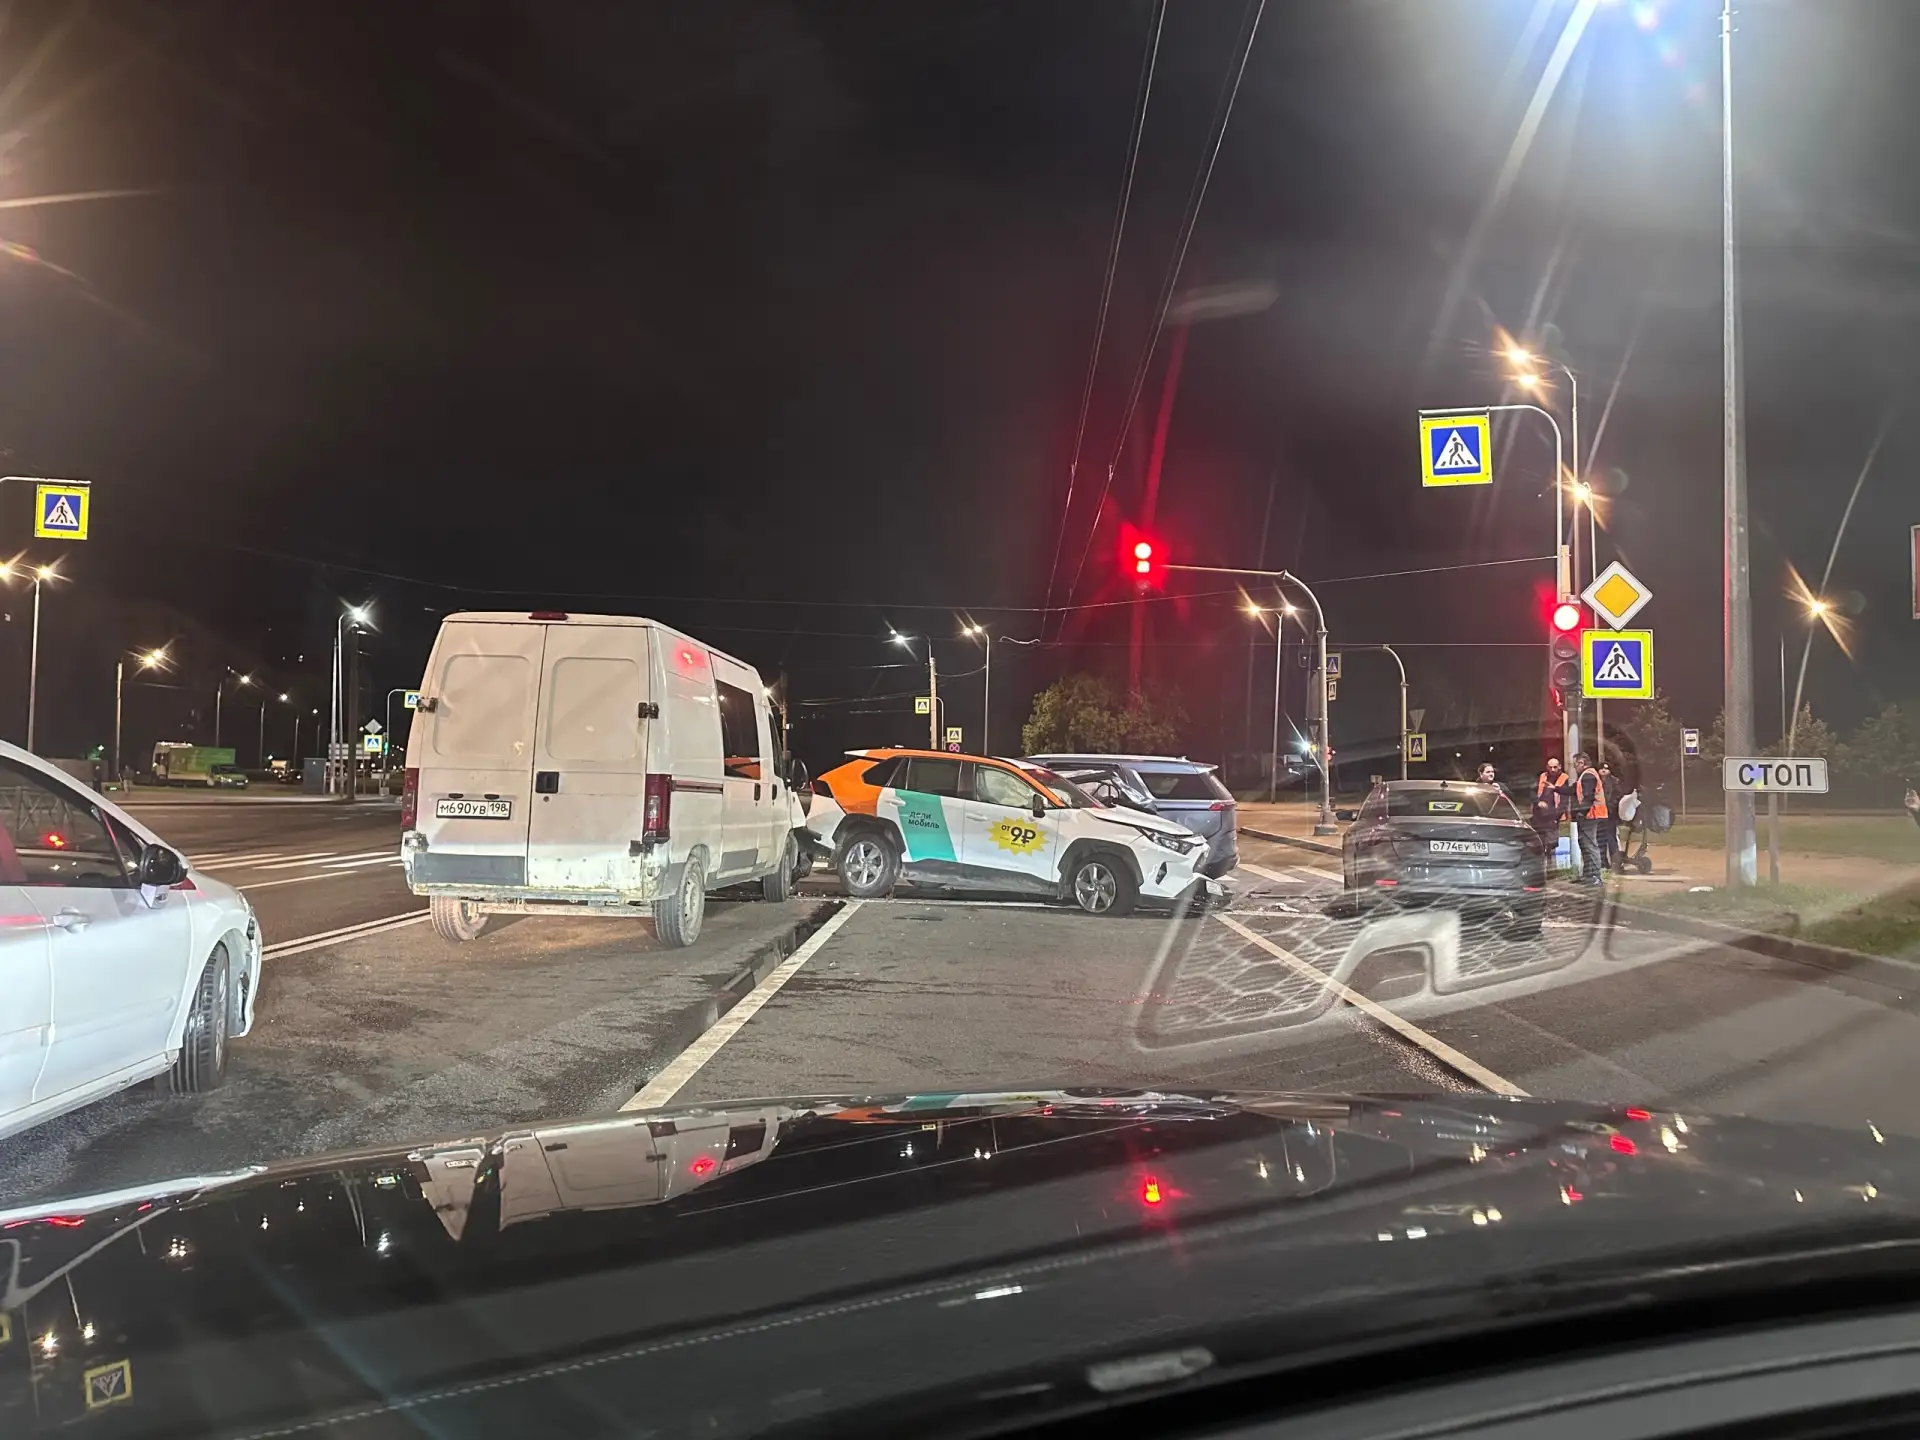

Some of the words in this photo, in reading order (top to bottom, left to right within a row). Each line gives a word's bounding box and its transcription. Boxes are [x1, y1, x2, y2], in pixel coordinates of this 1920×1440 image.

[1739, 763, 1812, 786] СТОП
[909, 811, 932, 820] дели
[908, 819, 940, 829] мобиль
